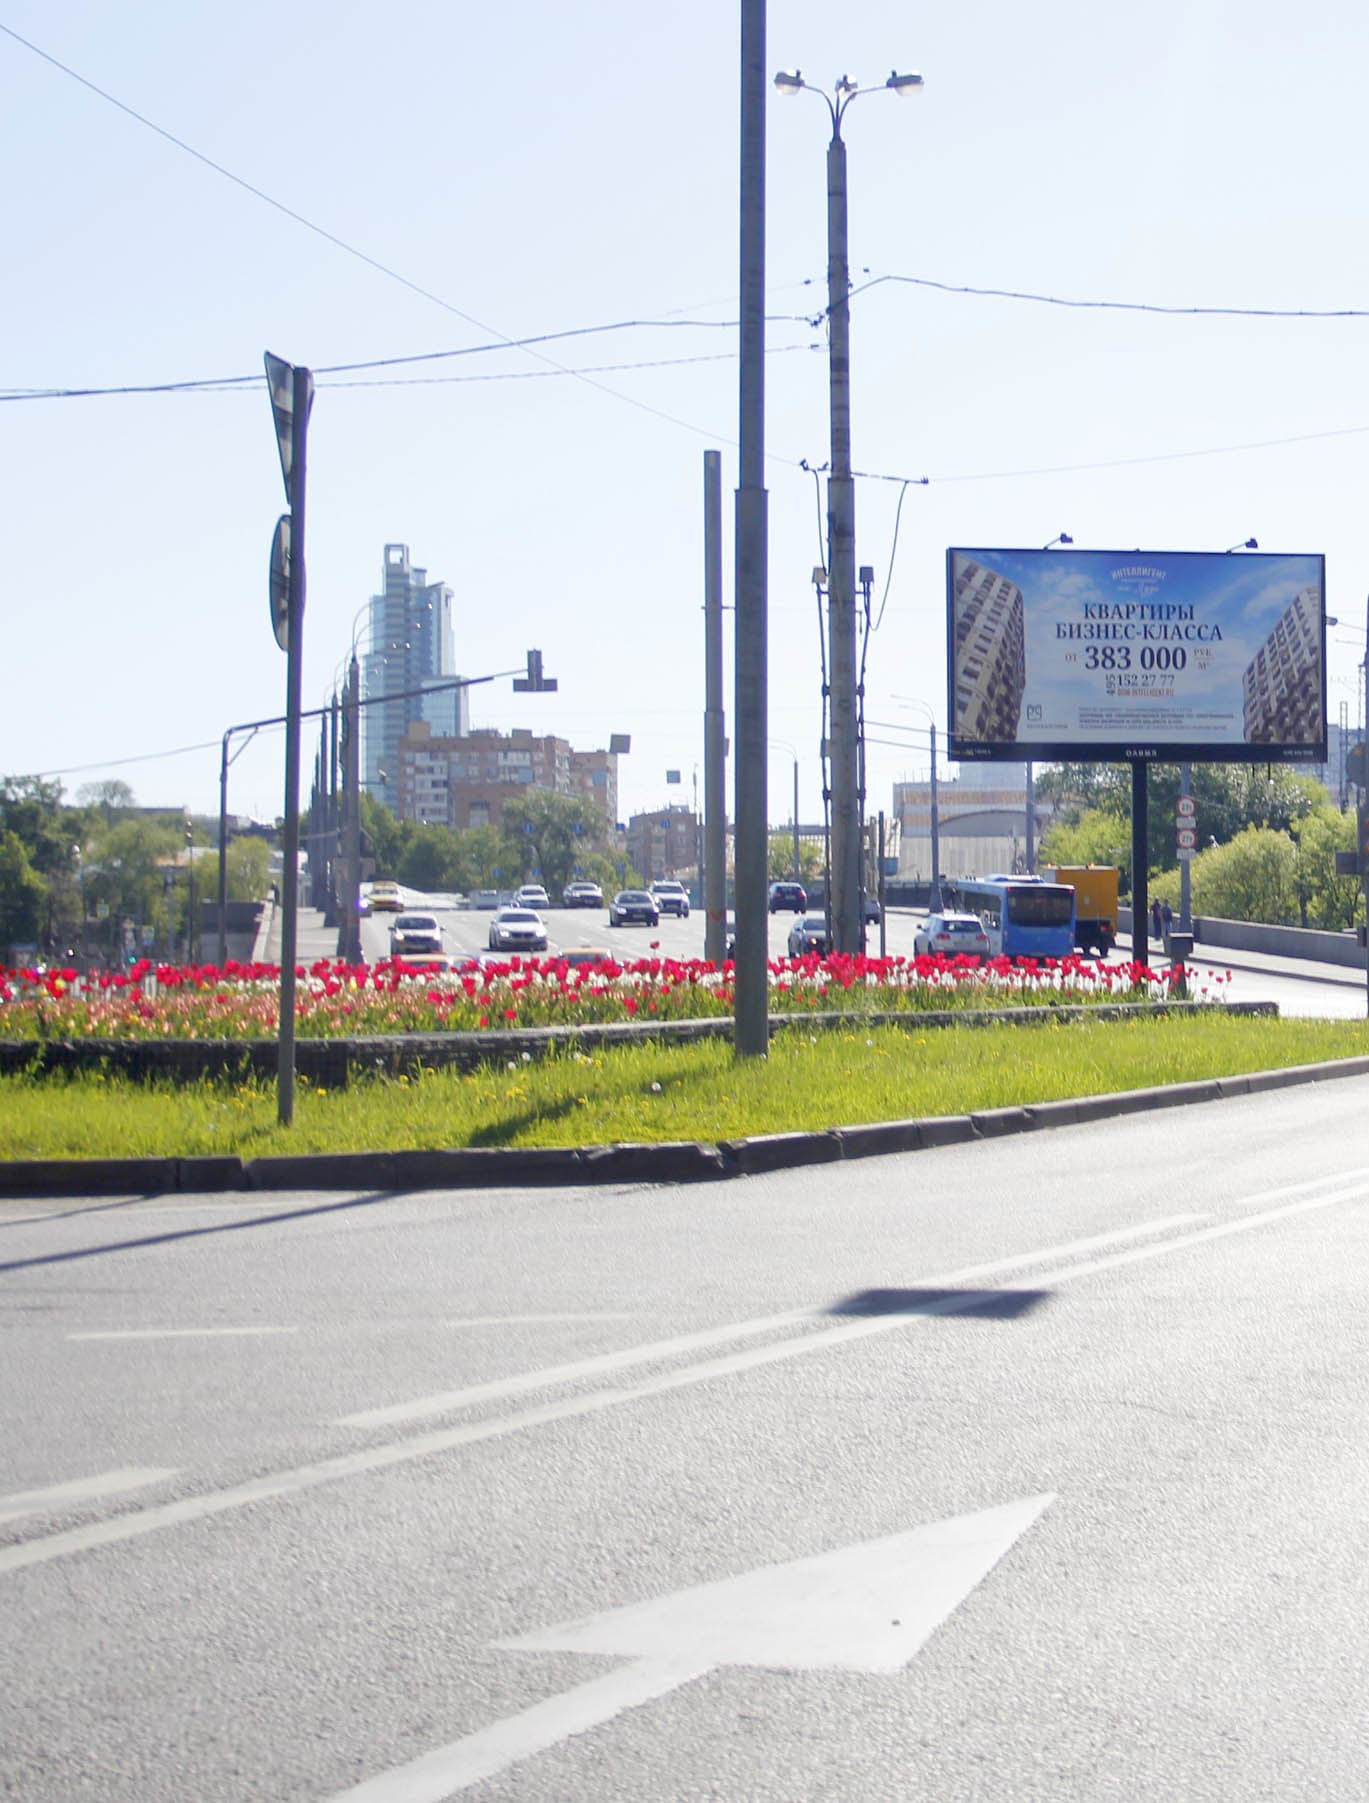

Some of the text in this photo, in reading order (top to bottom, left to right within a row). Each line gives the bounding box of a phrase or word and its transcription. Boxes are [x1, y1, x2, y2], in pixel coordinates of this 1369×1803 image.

[1084, 603, 1195, 621] КВАРТИРЫ
[1056, 622, 1223, 641] БИЗНЕС-КЛАССА
[1085, 646, 1132, 671] 383
[1140, 646, 1187, 671] 000
